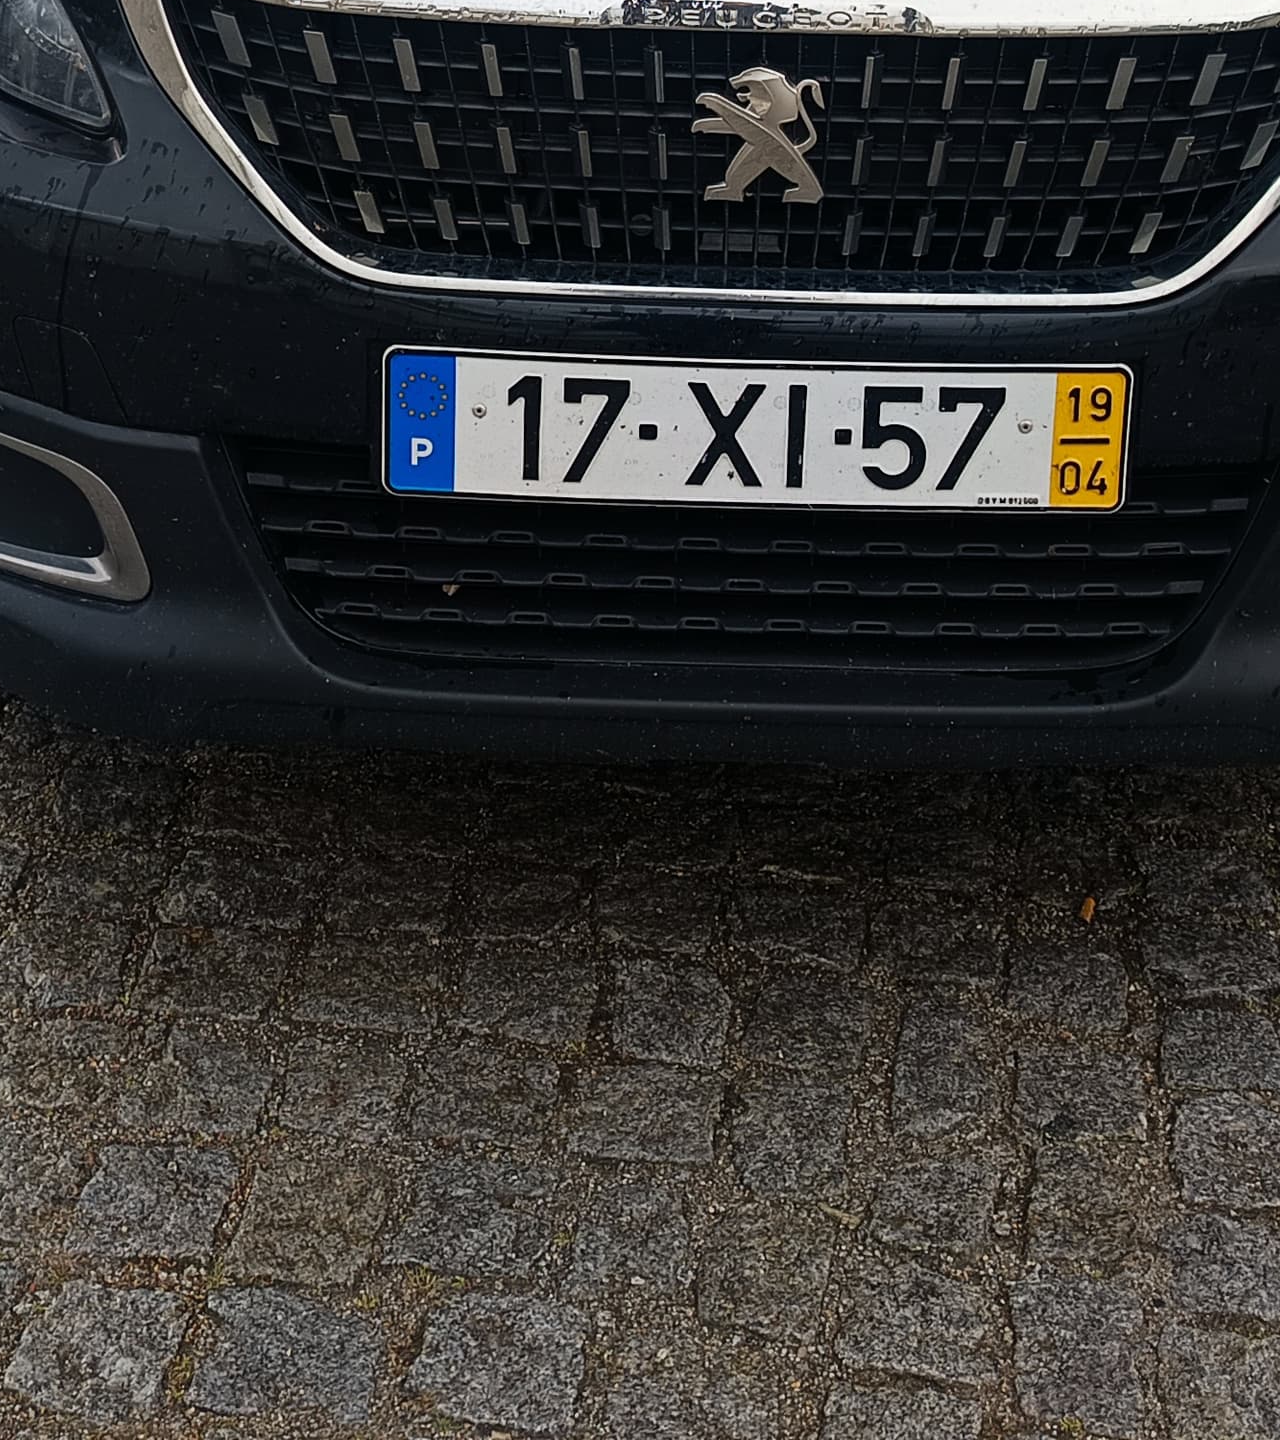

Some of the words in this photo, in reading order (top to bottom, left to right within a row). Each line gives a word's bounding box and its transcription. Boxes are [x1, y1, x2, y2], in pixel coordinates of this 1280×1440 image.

[1068, 386, 1113, 423] 19
[410, 437, 434, 466] P
[1058, 460, 1108, 496] 04
